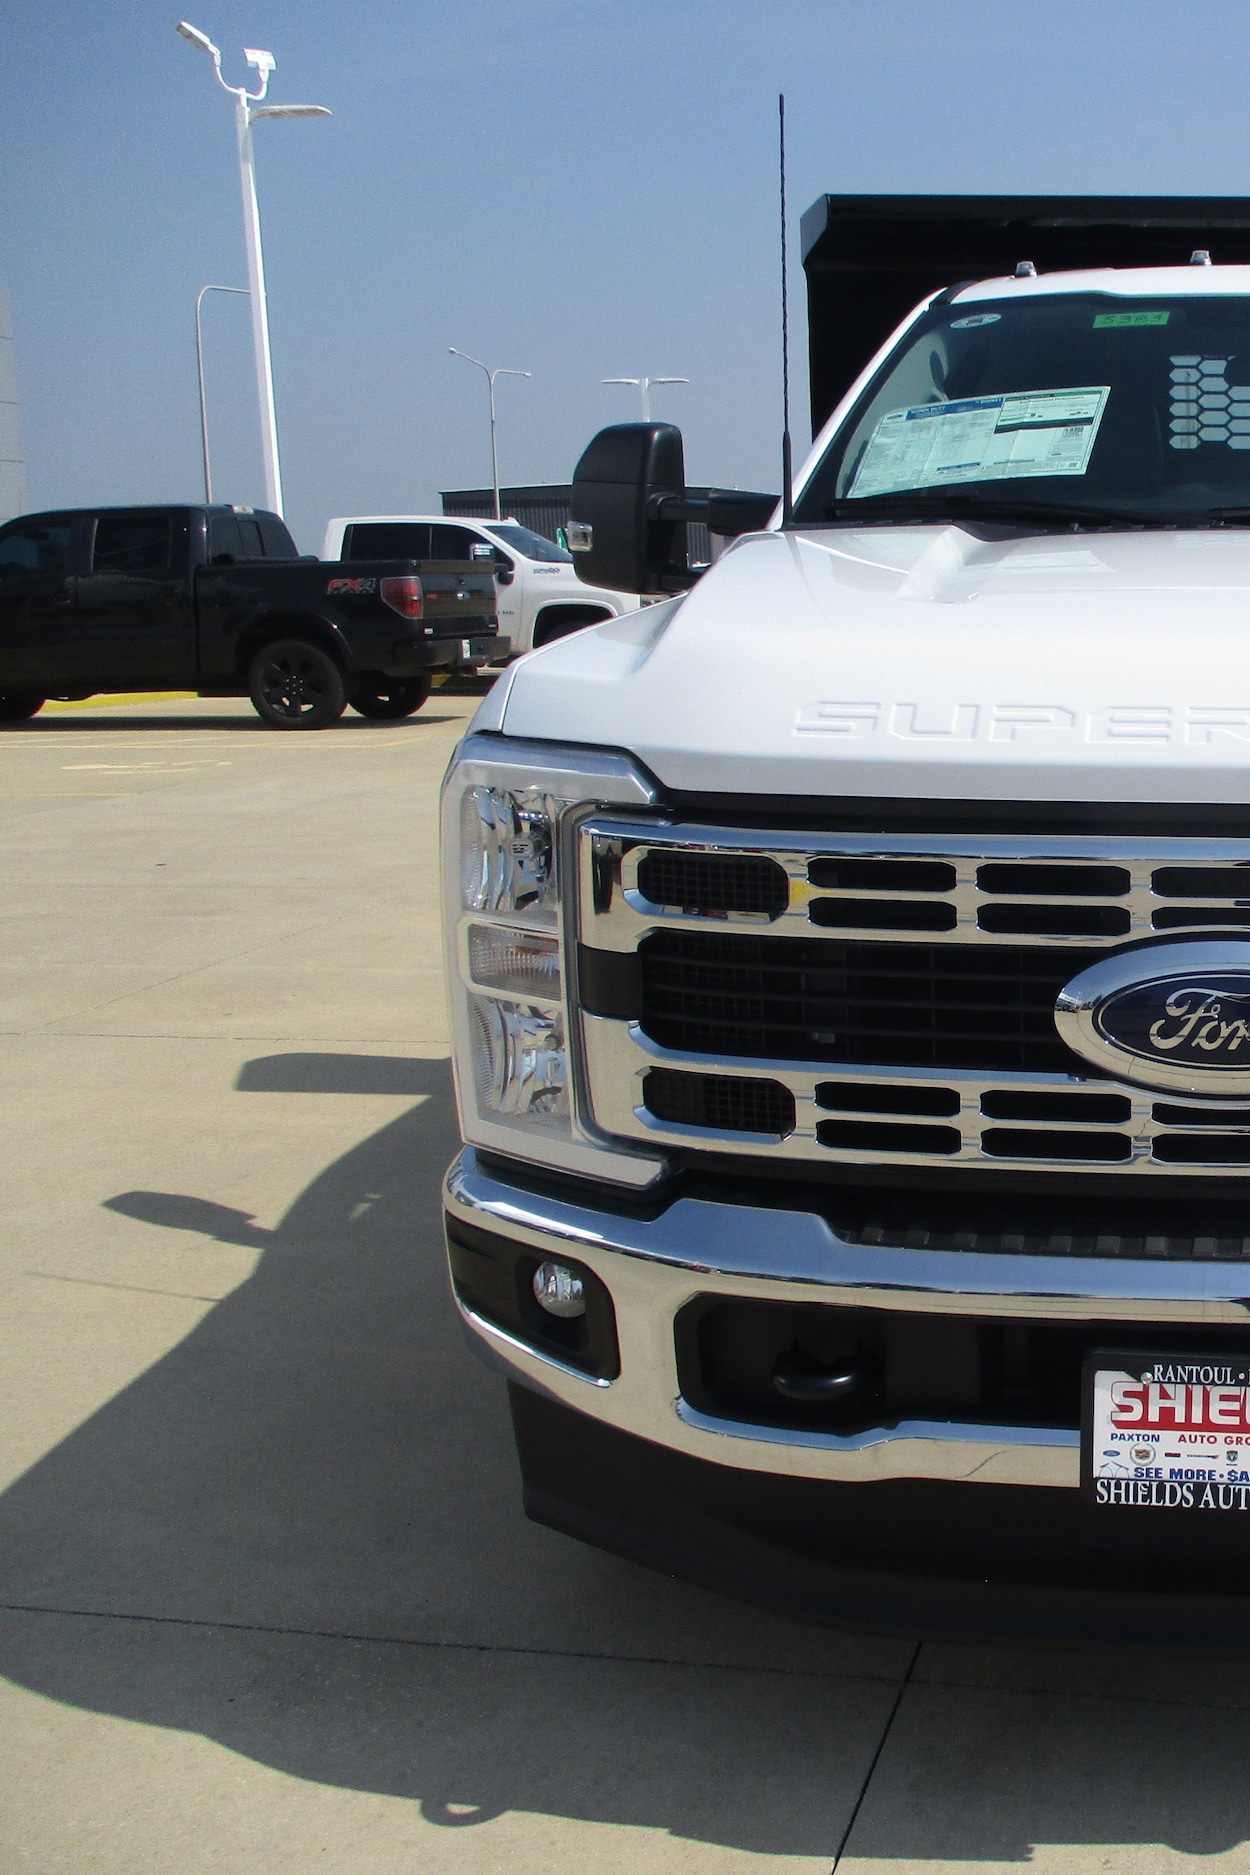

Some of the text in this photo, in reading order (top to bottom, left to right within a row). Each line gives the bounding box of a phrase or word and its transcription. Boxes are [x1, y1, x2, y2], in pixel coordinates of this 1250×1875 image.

[326, 578, 376, 591] FX4
[1153, 1364, 1235, 1385] RANTOUL
[1110, 1432, 1161, 1443] PAXTON
[1177, 1434, 1218, 1445] AUTO
[1133, 1467, 1163, 1479] SEE
[1169, 1468, 1217, 1481] MORE
[1096, 1479, 1195, 1509] SHIELDS
